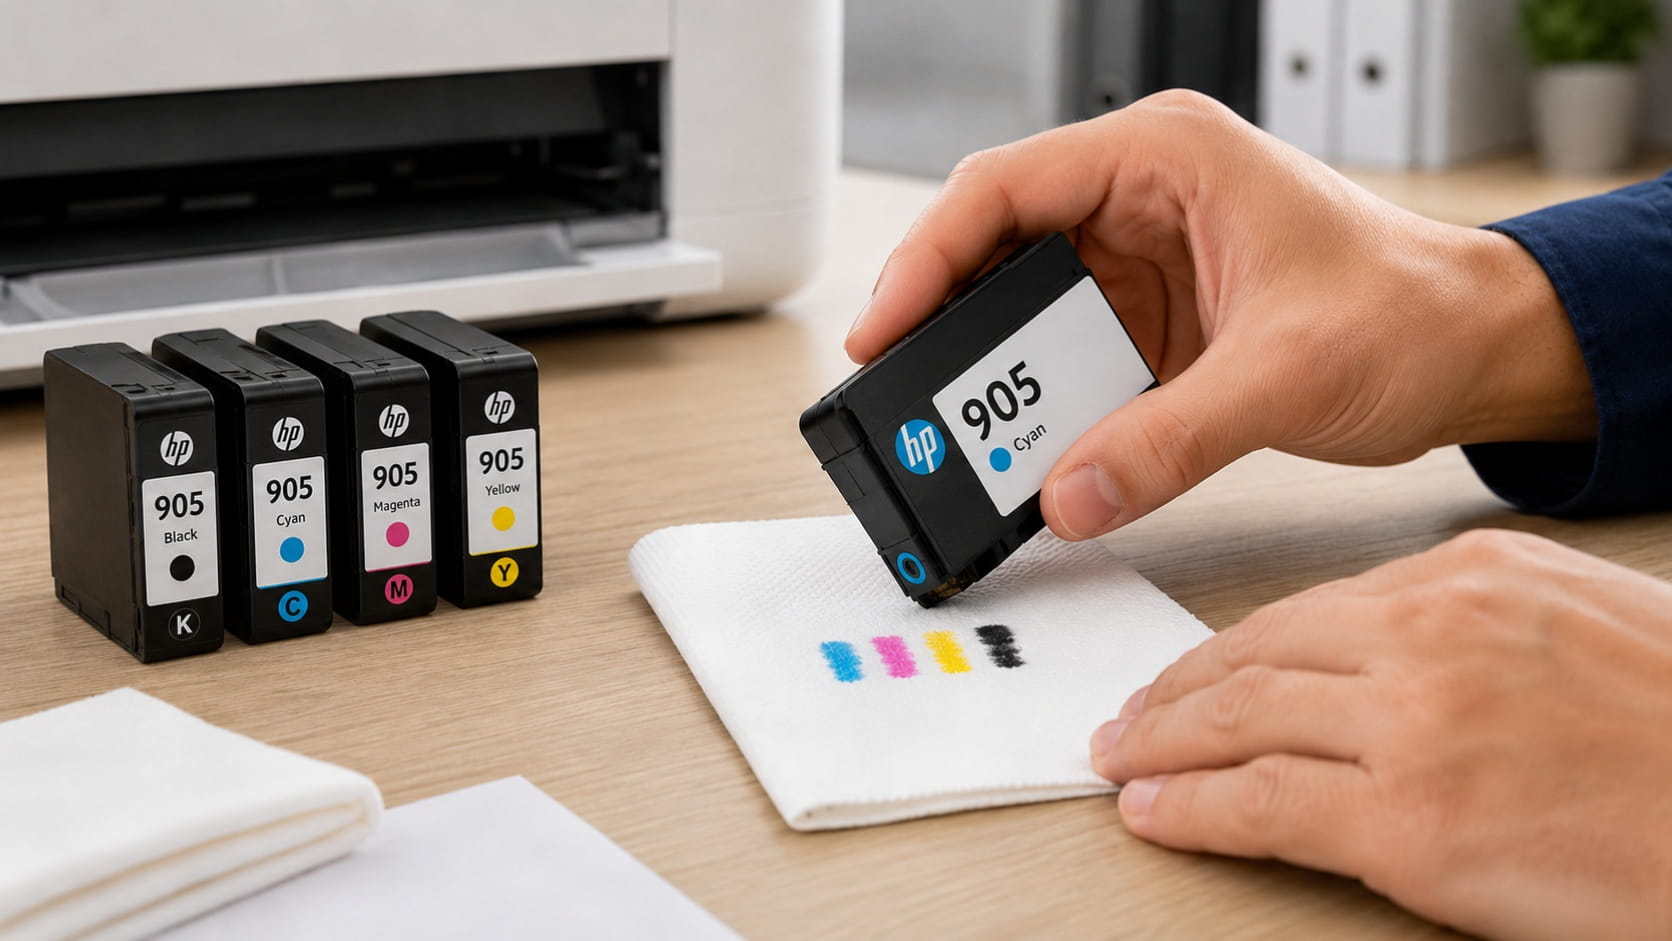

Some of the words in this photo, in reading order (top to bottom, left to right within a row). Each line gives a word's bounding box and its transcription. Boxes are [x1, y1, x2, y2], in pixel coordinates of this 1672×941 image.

[487, 391, 512, 424] hp
[962, 360, 1042, 442] 905
[275, 417, 301, 451] hp
[381, 404, 406, 437] hp
[163, 431, 191, 466] hp
[899, 422, 938, 475] hp
[1013, 424, 1047, 452] Cyan
[479, 446, 524, 475] 905
[266, 474, 313, 504] 905
[372, 461, 418, 490] 905
[485, 483, 521, 497] Yellow
[154, 490, 205, 521] 905
[374, 497, 421, 514] Magenta
[276, 513, 306, 529] Cyan
[164, 527, 199, 545] Black
[497, 563, 512, 582] Y
[390, 580, 409, 599] M
[284, 597, 301, 616] C
[176, 613, 193, 635] K
